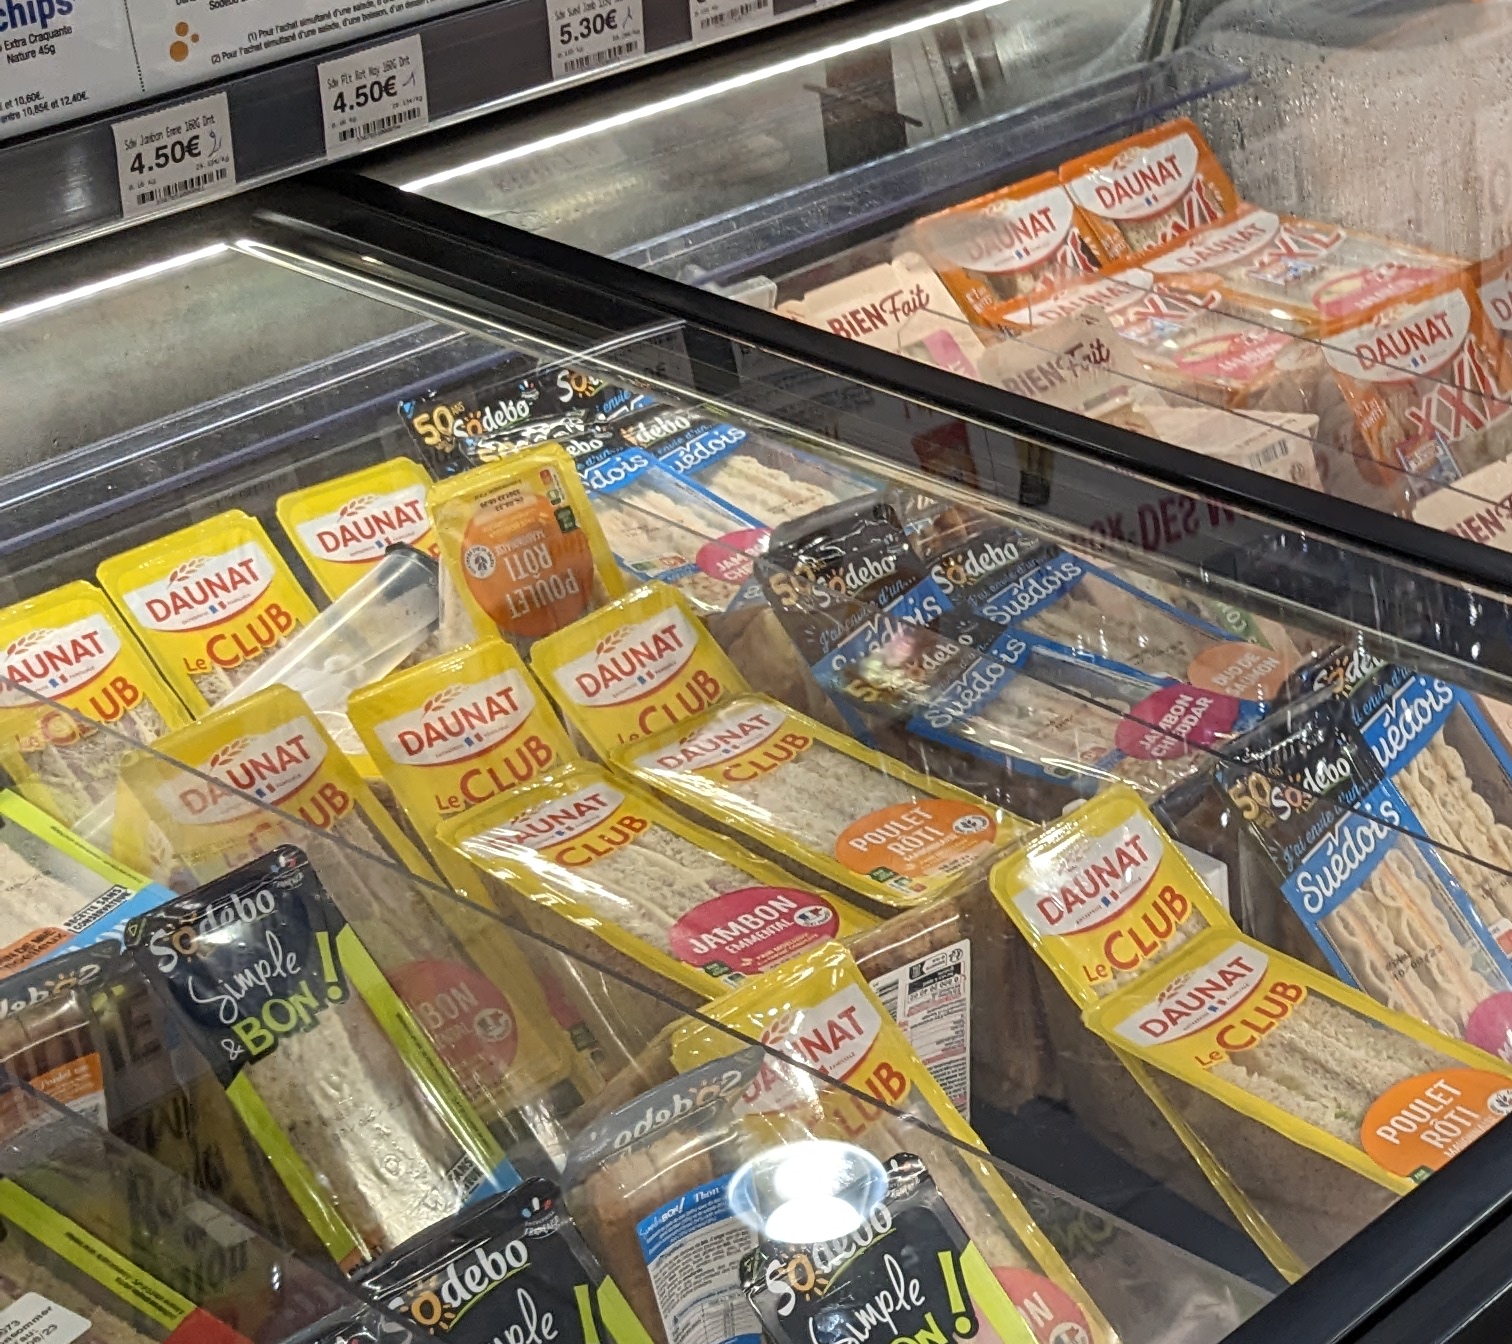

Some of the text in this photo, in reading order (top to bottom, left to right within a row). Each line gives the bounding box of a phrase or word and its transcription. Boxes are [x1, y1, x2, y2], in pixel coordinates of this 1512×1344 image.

[559, 7, 619, 46] 5.30€
[332, 74, 398, 114] 4.50€
[129, 134, 202, 175] 4.50€
[1095, 154, 1184, 211] DAUNAT
[881, 284, 932, 323] Fait
[1354, 311, 1455, 372] DAUNAT
[316, 498, 427, 555] DAUNAT
[145, 555, 261, 625] DAUNAT
[507, 567, 582, 618] POULET
[931, 541, 1020, 595] Sodebo
[982, 559, 1082, 626] Suédois
[206, 601, 297, 671] CLUB
[575, 623, 681, 698] DAUNAT
[923, 636, 1028, 729] Suédois
[397, 686, 518, 757] DAUNAT
[656, 712, 772, 772] DAUNAT
[178, 733, 312, 818] DAUNAT
[459, 735, 553, 806] CLUB
[723, 732, 811, 784] CLUB
[556, 813, 649, 868] CLUB
[848, 806, 934, 853] POULET
[1296, 795, 1402, 915] Suédois
[1034, 833, 1146, 928] DAUNAT
[688, 894, 798, 956] JAMBON
[724, 918, 795, 955] EMMENTAL
[1082, 887, 1191, 985] Le CLUB
[188, 930, 301, 1024] Simple
[1138, 956, 1250, 1041] DAUNAT
[1194, 978, 1305, 1070] Le CLUB
[1375, 1077, 1464, 1146] POULET
[1419, 1106, 1481, 1153] RÔTI
